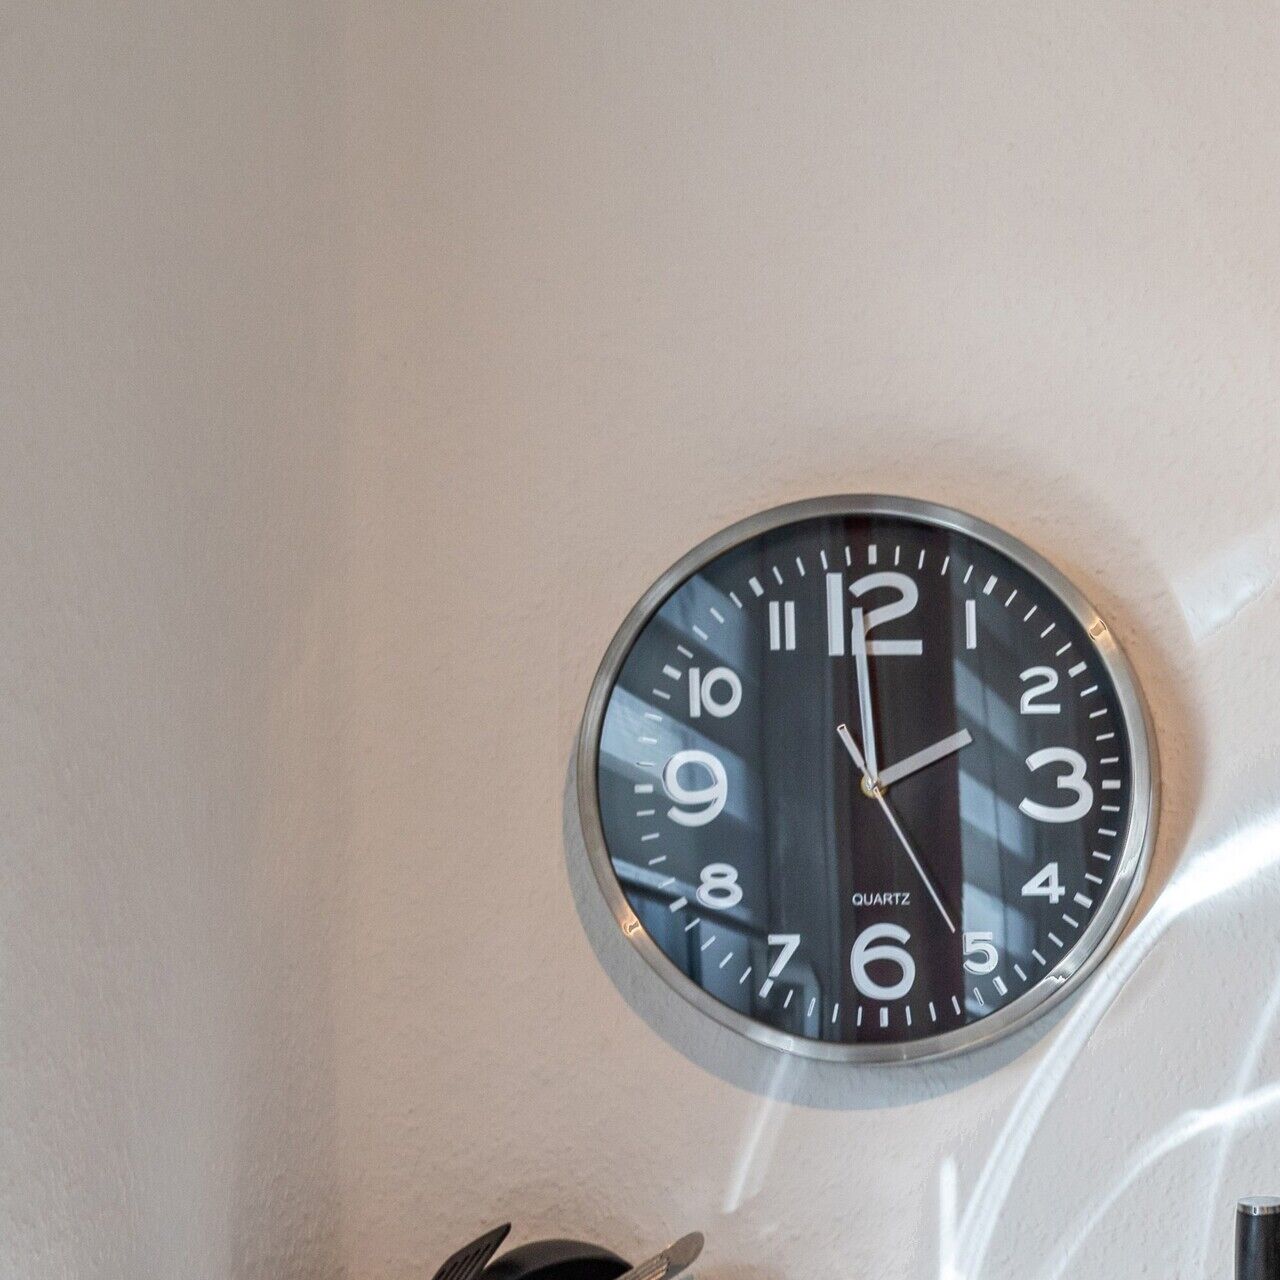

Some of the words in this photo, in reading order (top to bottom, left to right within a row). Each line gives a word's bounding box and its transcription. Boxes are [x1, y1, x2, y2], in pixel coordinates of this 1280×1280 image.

[769, 601, 795, 650] 11
[826, 571, 923, 656] 12
[965, 600, 977, 649] 1
[689, 667, 742, 718] 10
[1019, 666, 1060, 714] 2
[661, 750, 728, 827] 9
[1018, 747, 1094, 823] 3
[696, 863, 743, 910] 8
[852, 892, 910, 906] QUARTZ
[1021, 862, 1065, 903] 4
[759, 934, 800, 998] 7
[850, 923, 916, 1000] 6
[963, 932, 998, 975] 5
